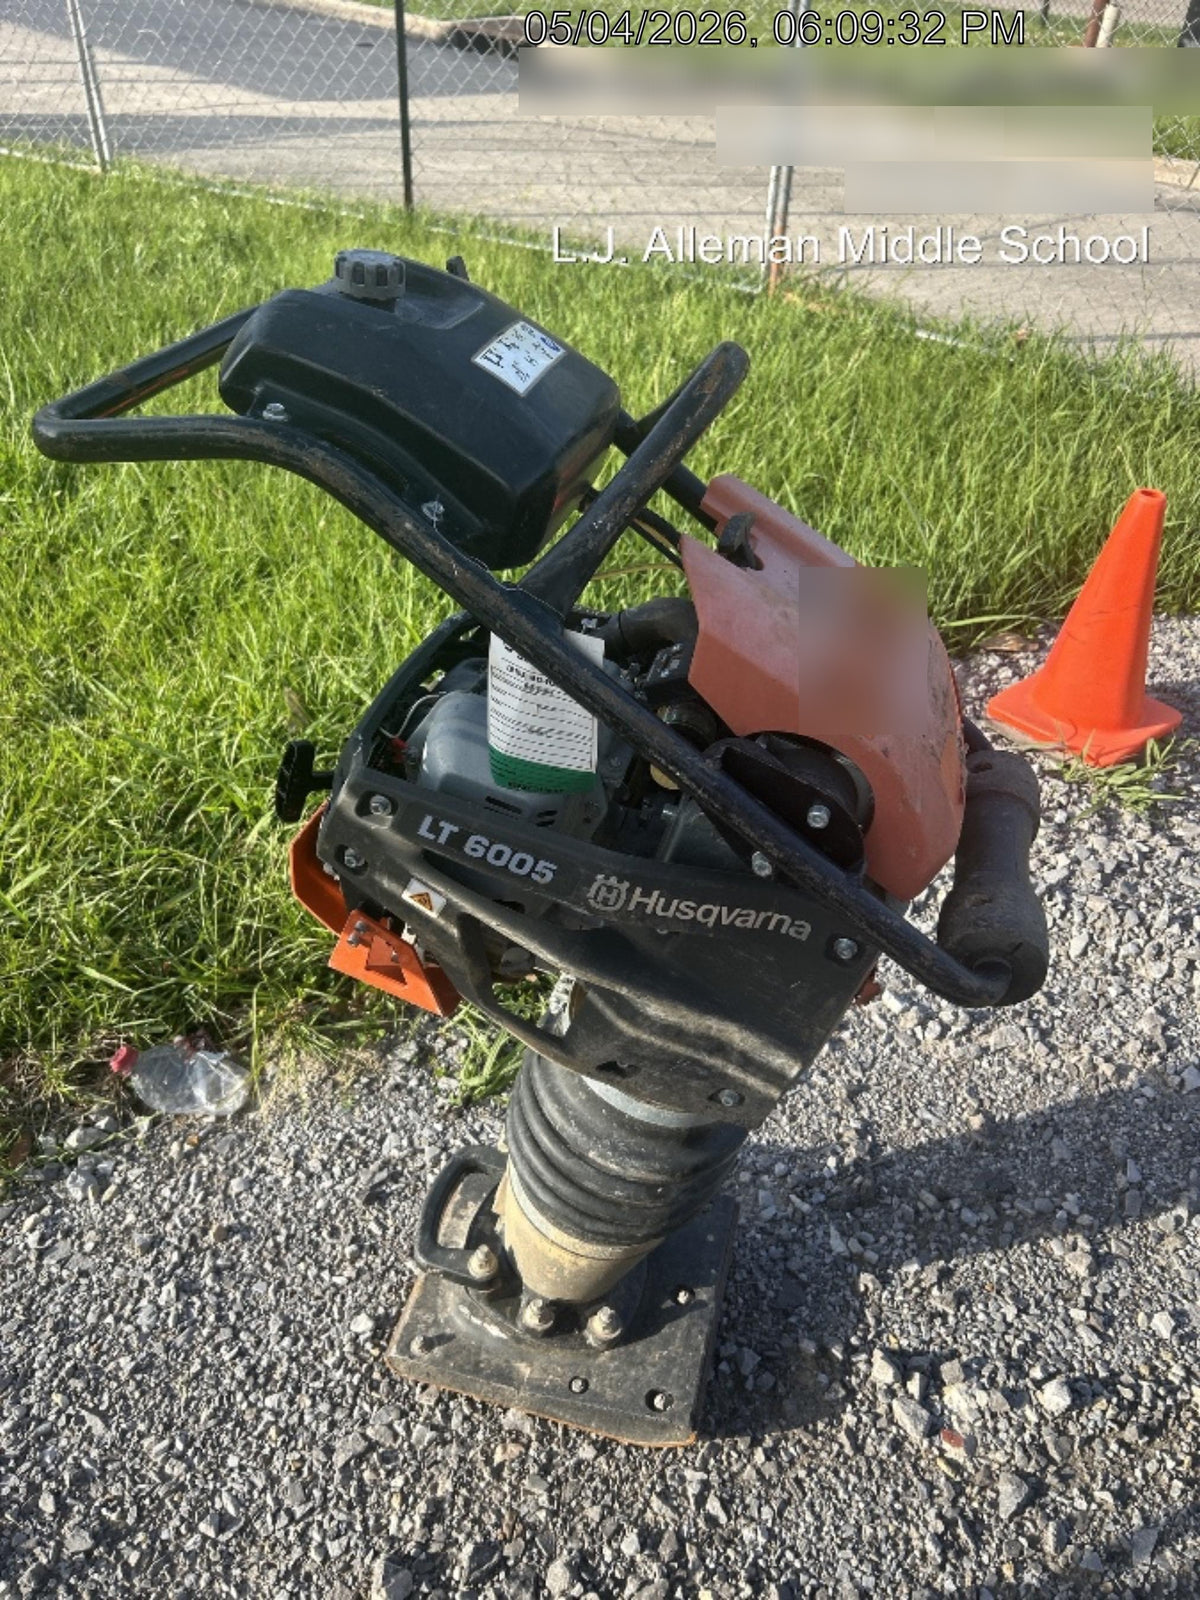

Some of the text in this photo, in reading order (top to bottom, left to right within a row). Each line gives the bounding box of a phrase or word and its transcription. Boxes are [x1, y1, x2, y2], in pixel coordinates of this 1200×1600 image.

[417, 814, 557, 885] LT 6005
[628, 886, 812, 942] Husqvarna
